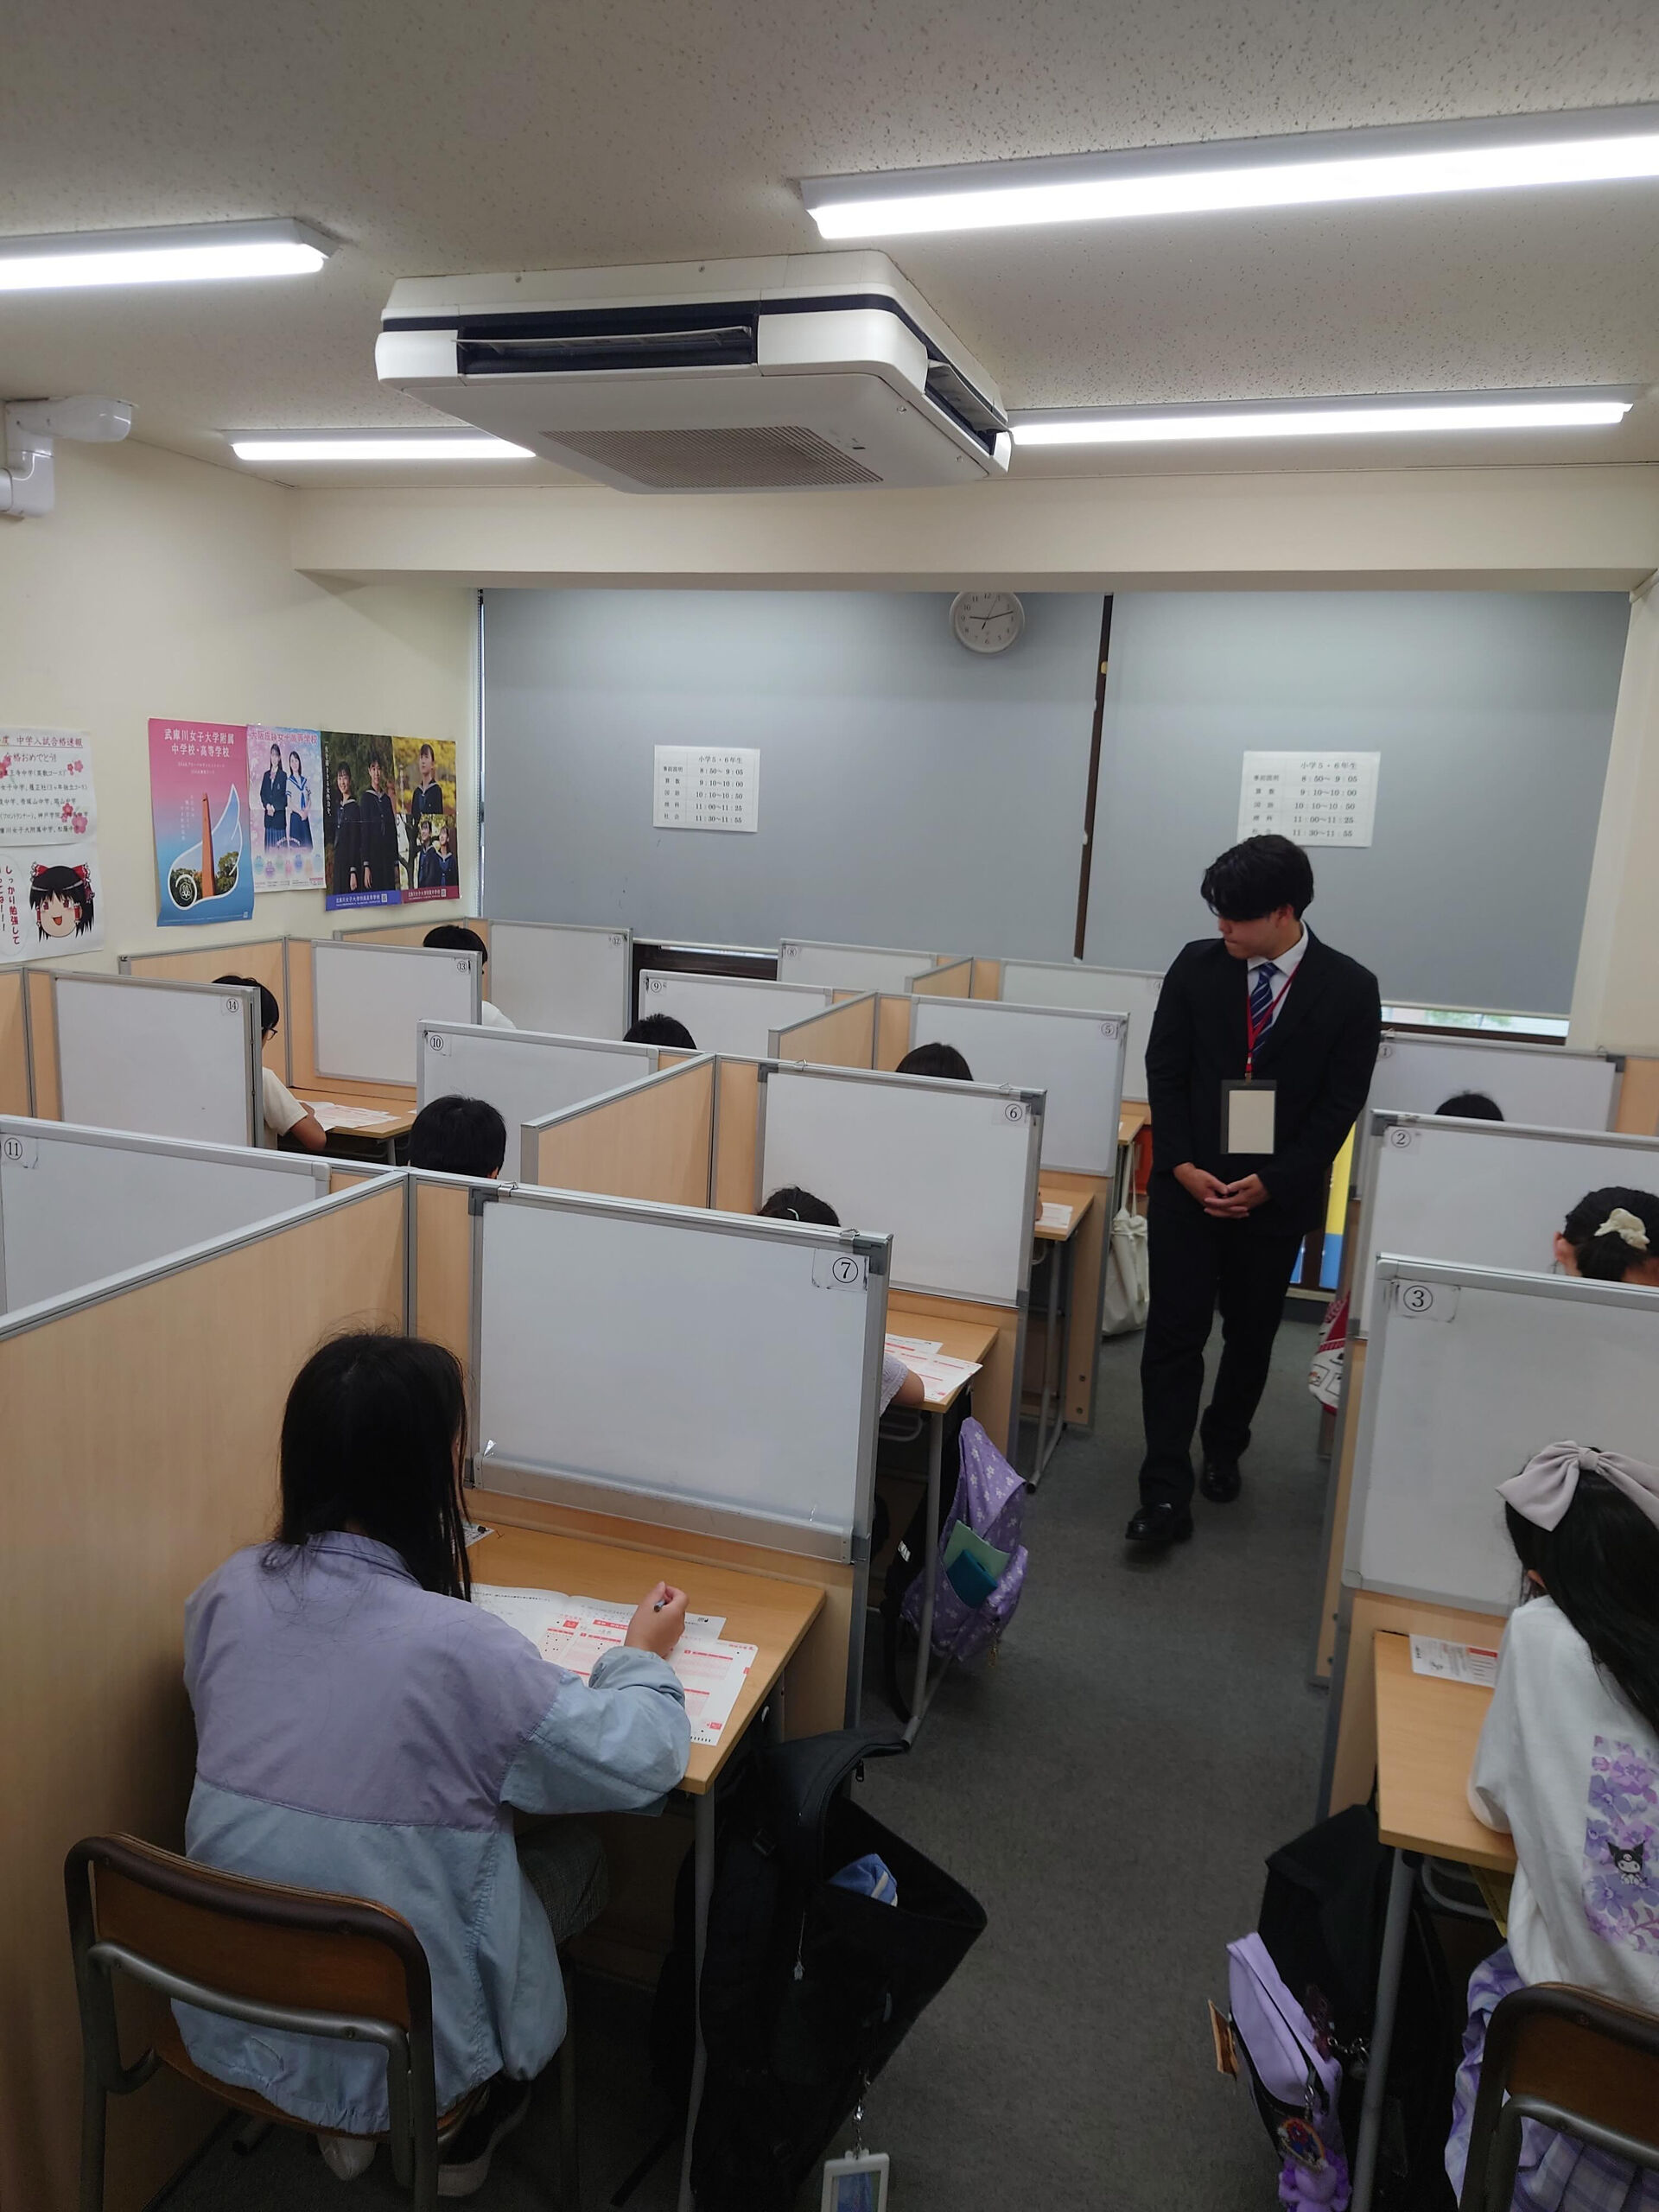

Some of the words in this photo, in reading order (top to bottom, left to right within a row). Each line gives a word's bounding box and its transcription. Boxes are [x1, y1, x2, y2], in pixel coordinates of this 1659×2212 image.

[164, 728, 234, 745] 武庫川女子大学附属
[171, 743, 230, 758] 中学校・高等学校
[5, 865, 20, 945] しっかり勉強して
